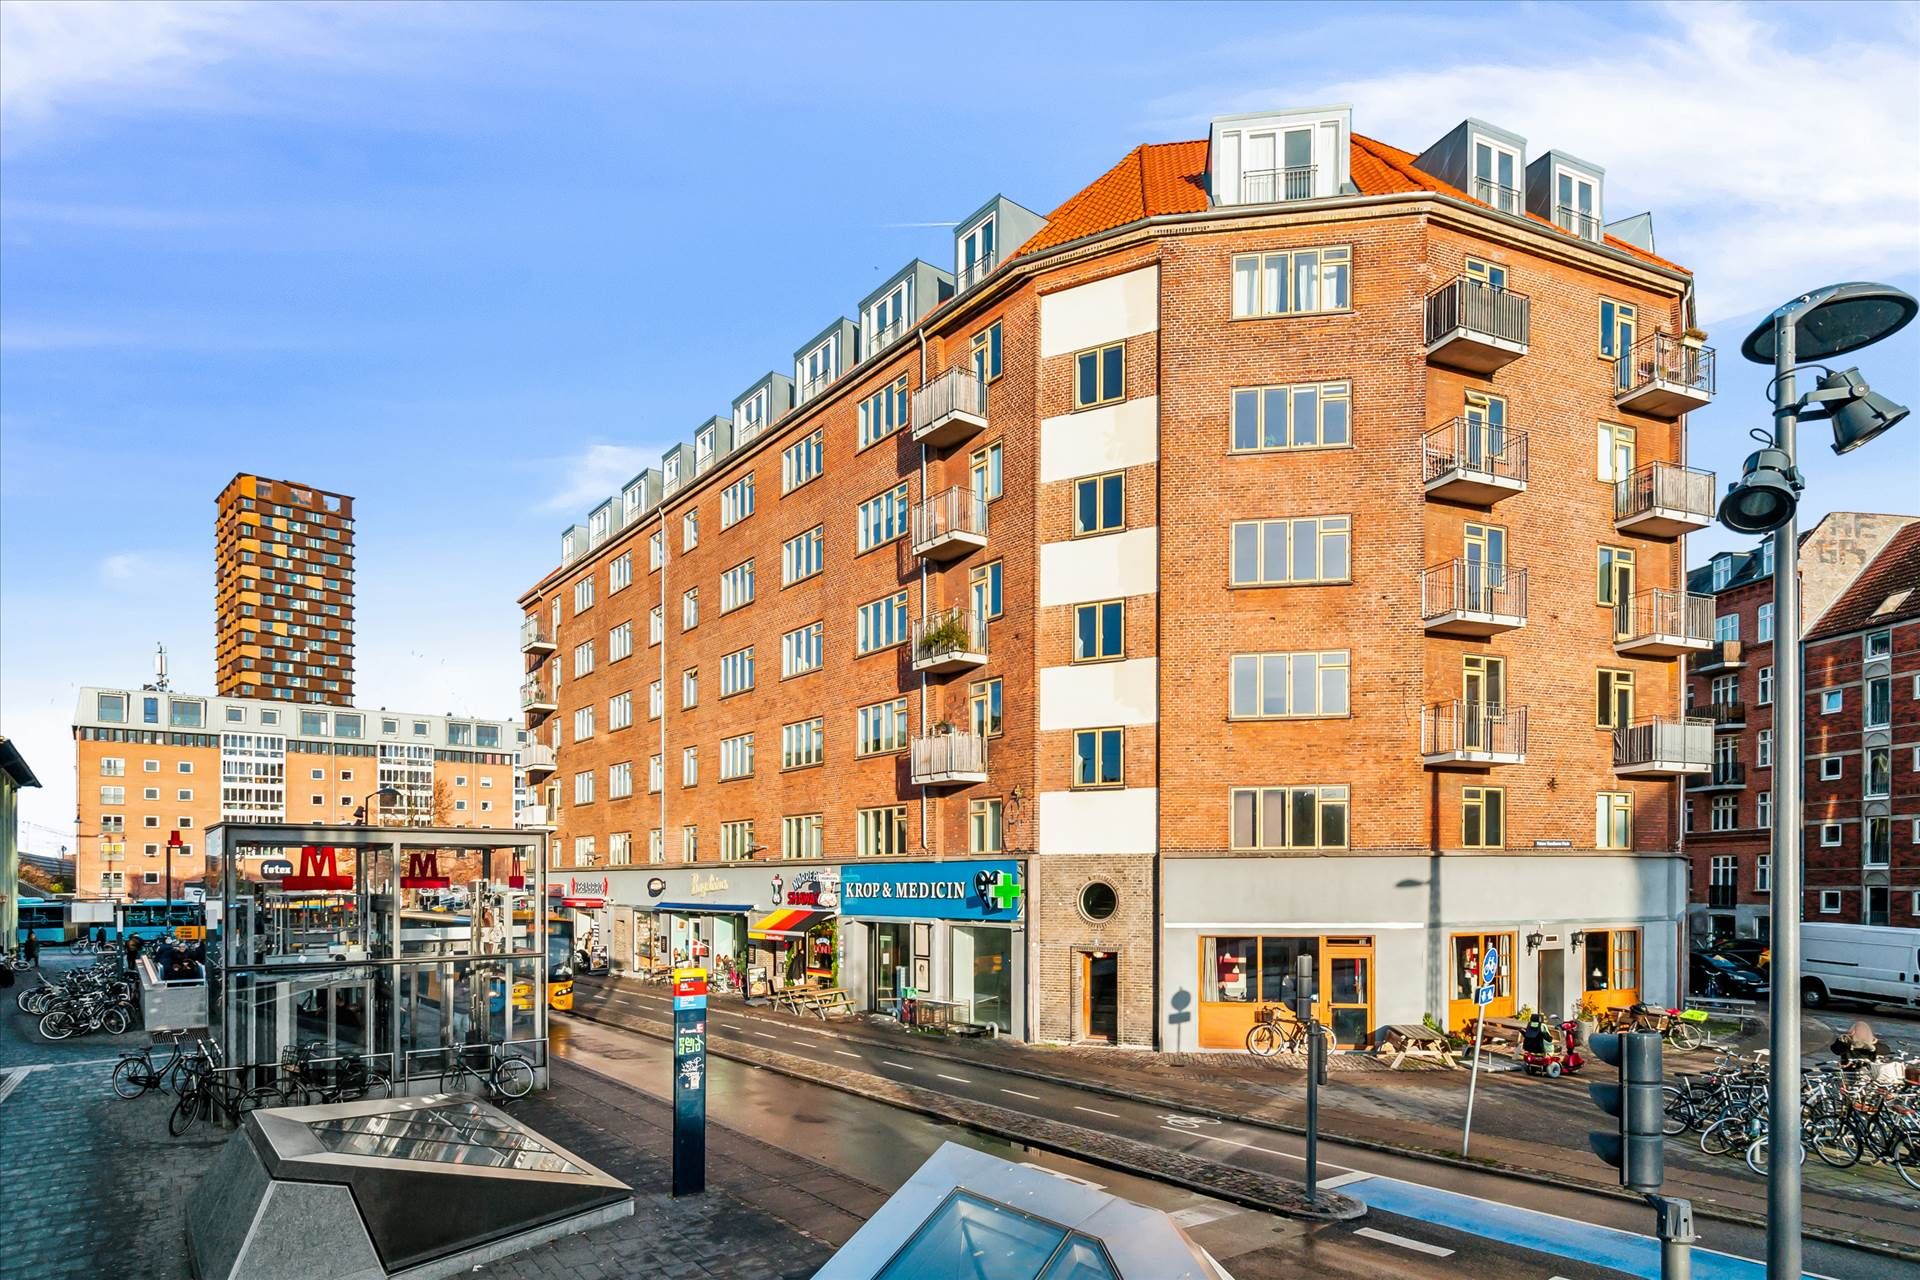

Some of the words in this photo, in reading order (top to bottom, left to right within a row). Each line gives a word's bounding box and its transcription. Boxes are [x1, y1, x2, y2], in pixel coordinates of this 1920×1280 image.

[845, 882, 881, 899] KROP
[882, 883, 892, 898] &
[895, 881, 966, 899] MEDICIN
